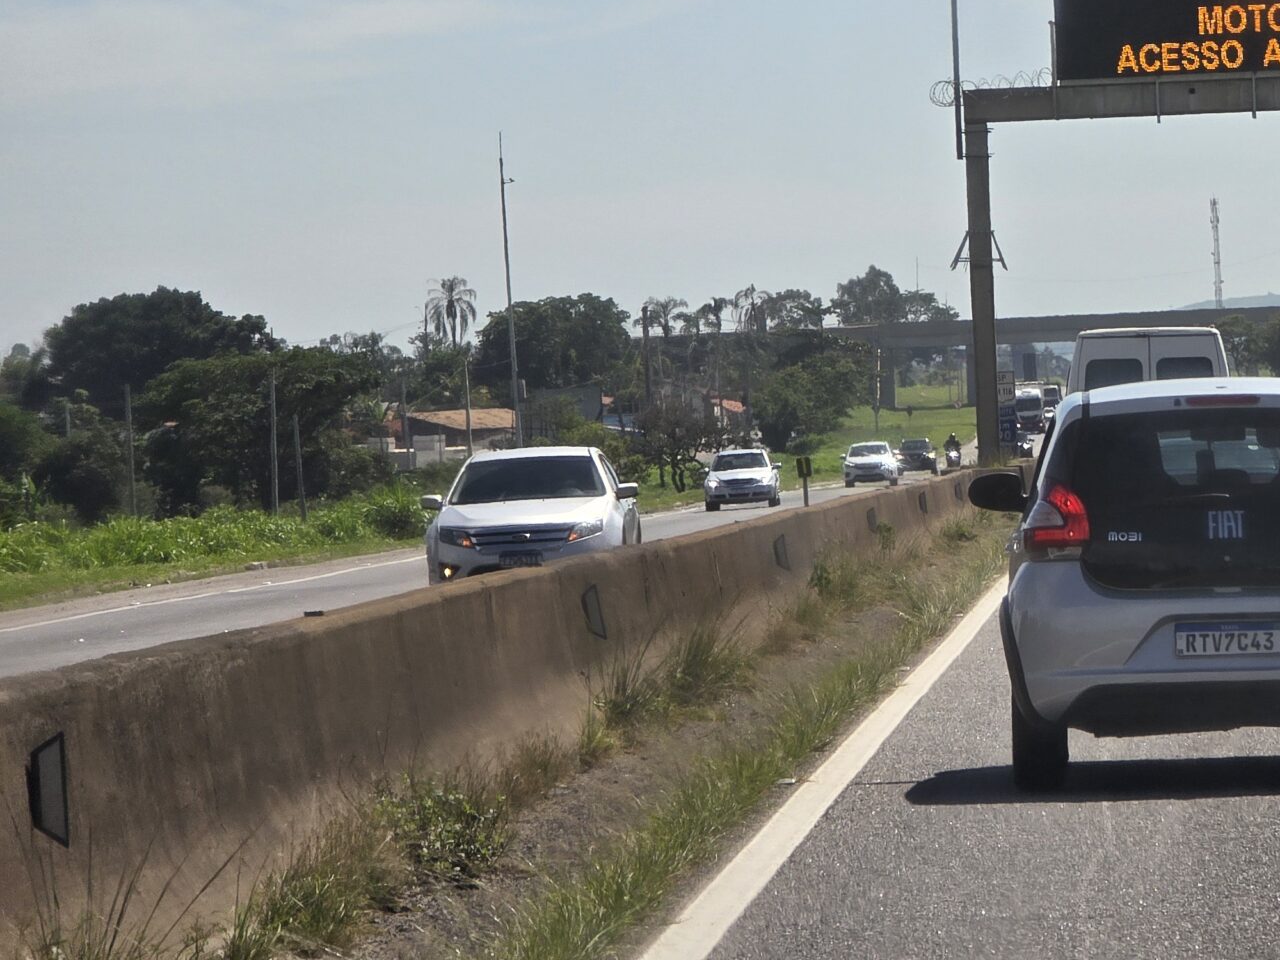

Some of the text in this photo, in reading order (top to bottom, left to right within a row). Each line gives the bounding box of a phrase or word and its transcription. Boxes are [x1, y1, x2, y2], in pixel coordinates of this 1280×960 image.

[1117, 39, 1244, 73] ACESSO
[1108, 531, 1142, 542] MOBI
[1207, 510, 1245, 540] FIAT
[1185, 632, 1275, 653] RTV7C43
